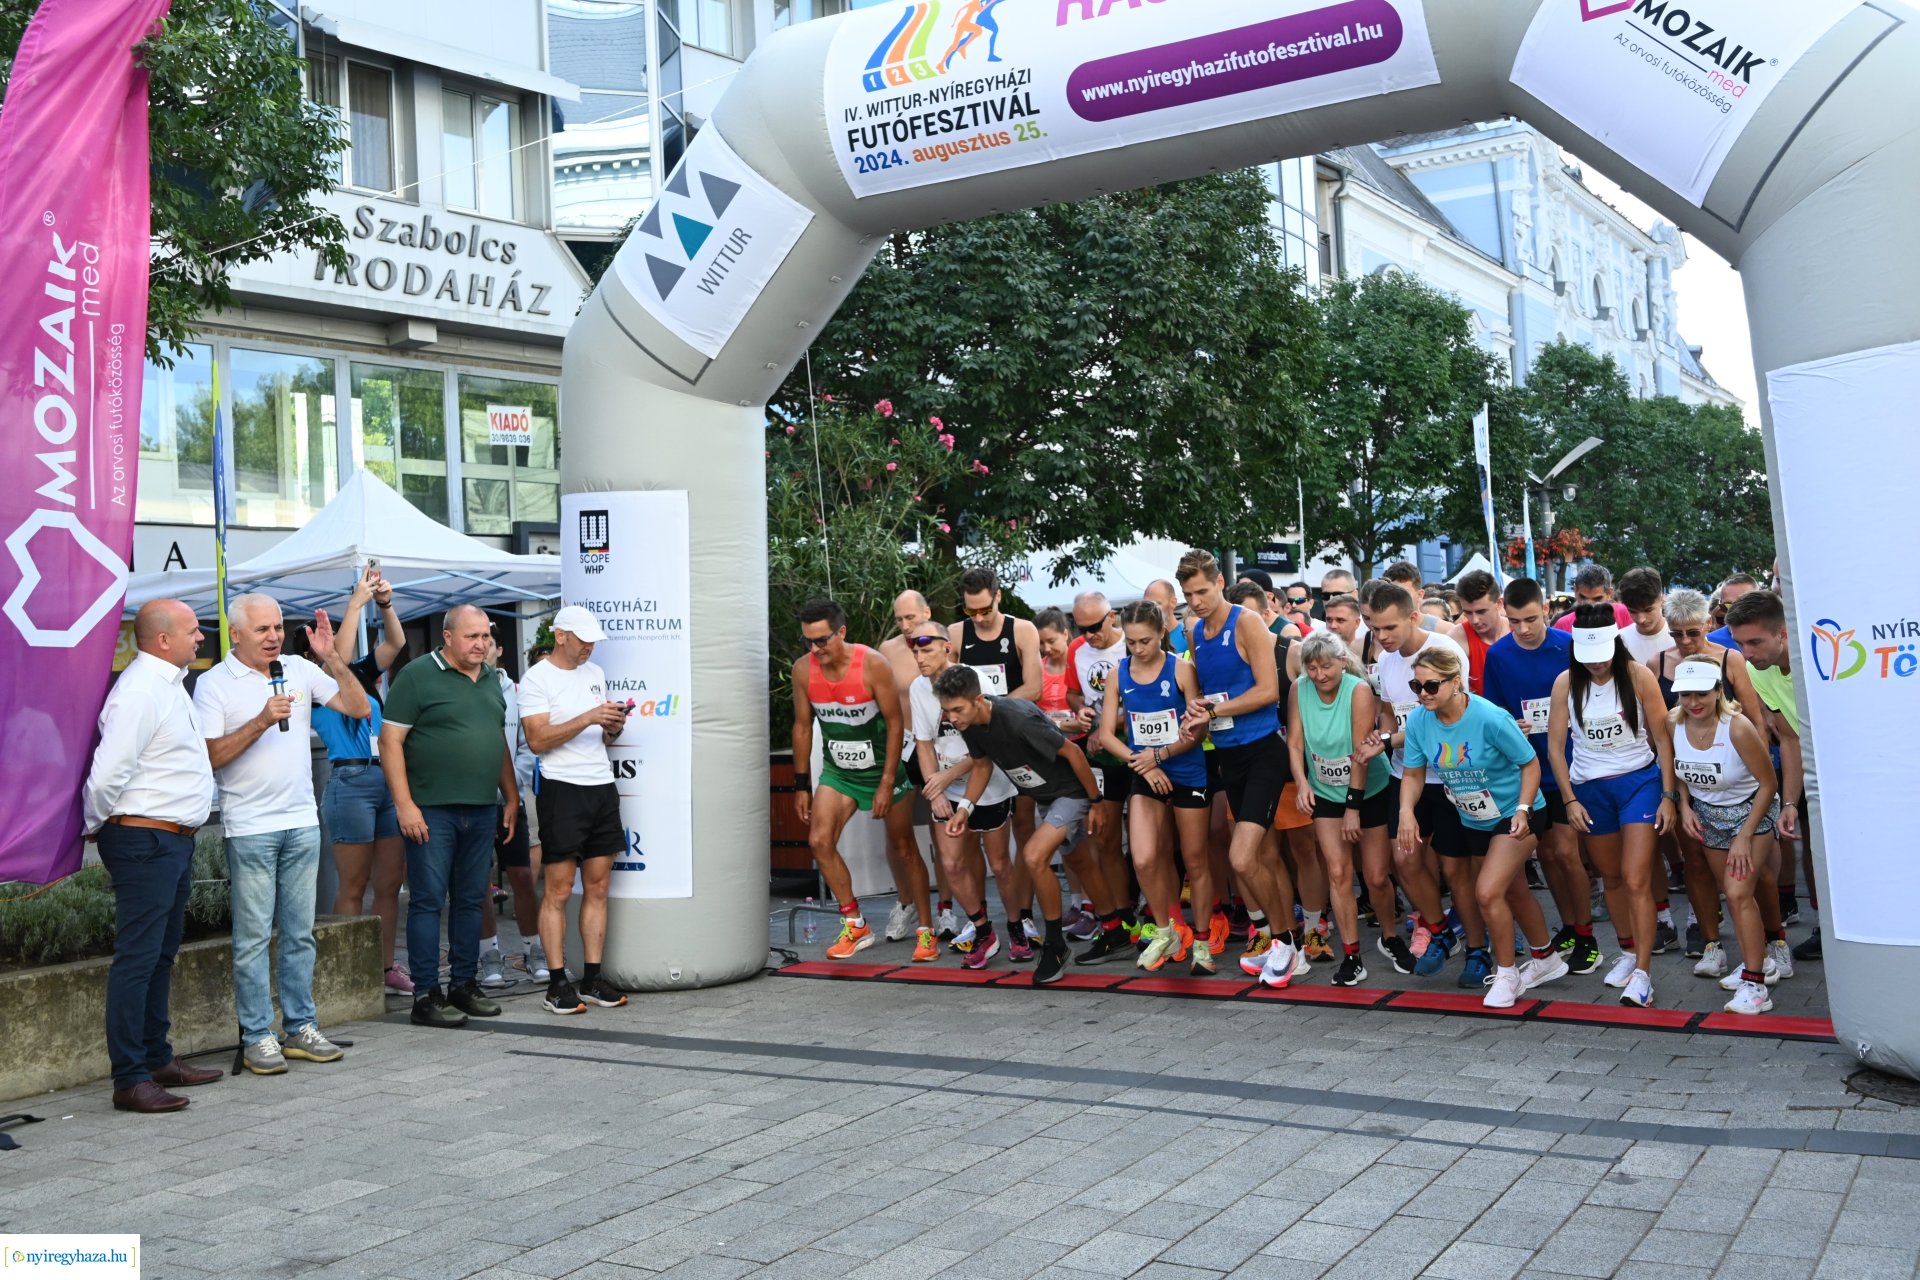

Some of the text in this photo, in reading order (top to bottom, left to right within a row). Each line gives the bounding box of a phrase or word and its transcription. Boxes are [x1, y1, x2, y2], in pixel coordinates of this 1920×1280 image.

[1082, 22, 1383, 102] www.nyiregyhazifutofesztival.hu
[1614, 32, 1732, 114] Az orvosi futóközösség
[844, 68, 1031, 123] IV. WITTUR-NYÍREGYHÁZI
[1707, 69, 1747, 98] med
[847, 88, 1040, 153] FUTÓFESZTIVÁL
[854, 121, 1048, 174] 2024. augusztus 25.
[352, 204, 518, 265] Szabolcs
[696, 227, 753, 295] WITTUR
[78, 240, 101, 316] med
[313, 250, 553, 316] IRODAHÁZ
[107, 323, 125, 507] Az orvosi futóközösség
[490, 408, 529, 432] KIADÓ
[579, 553, 610, 564] SCOPE
[584, 565, 604, 575] WHP
[599, 618, 682, 631] TCENTRUM
[637, 634, 668, 643] Nonprofit
[605, 677, 647, 691] YHÁZA
[640, 693, 679, 717] ad!
[1139, 721, 1170, 735] 5091
[1587, 724, 1623, 740] 5073
[837, 751, 867, 761] 5220
[1320, 765, 1351, 777] 5009
[1463, 768, 1486, 778] CITY
[1684, 772, 1717, 785] 5209
